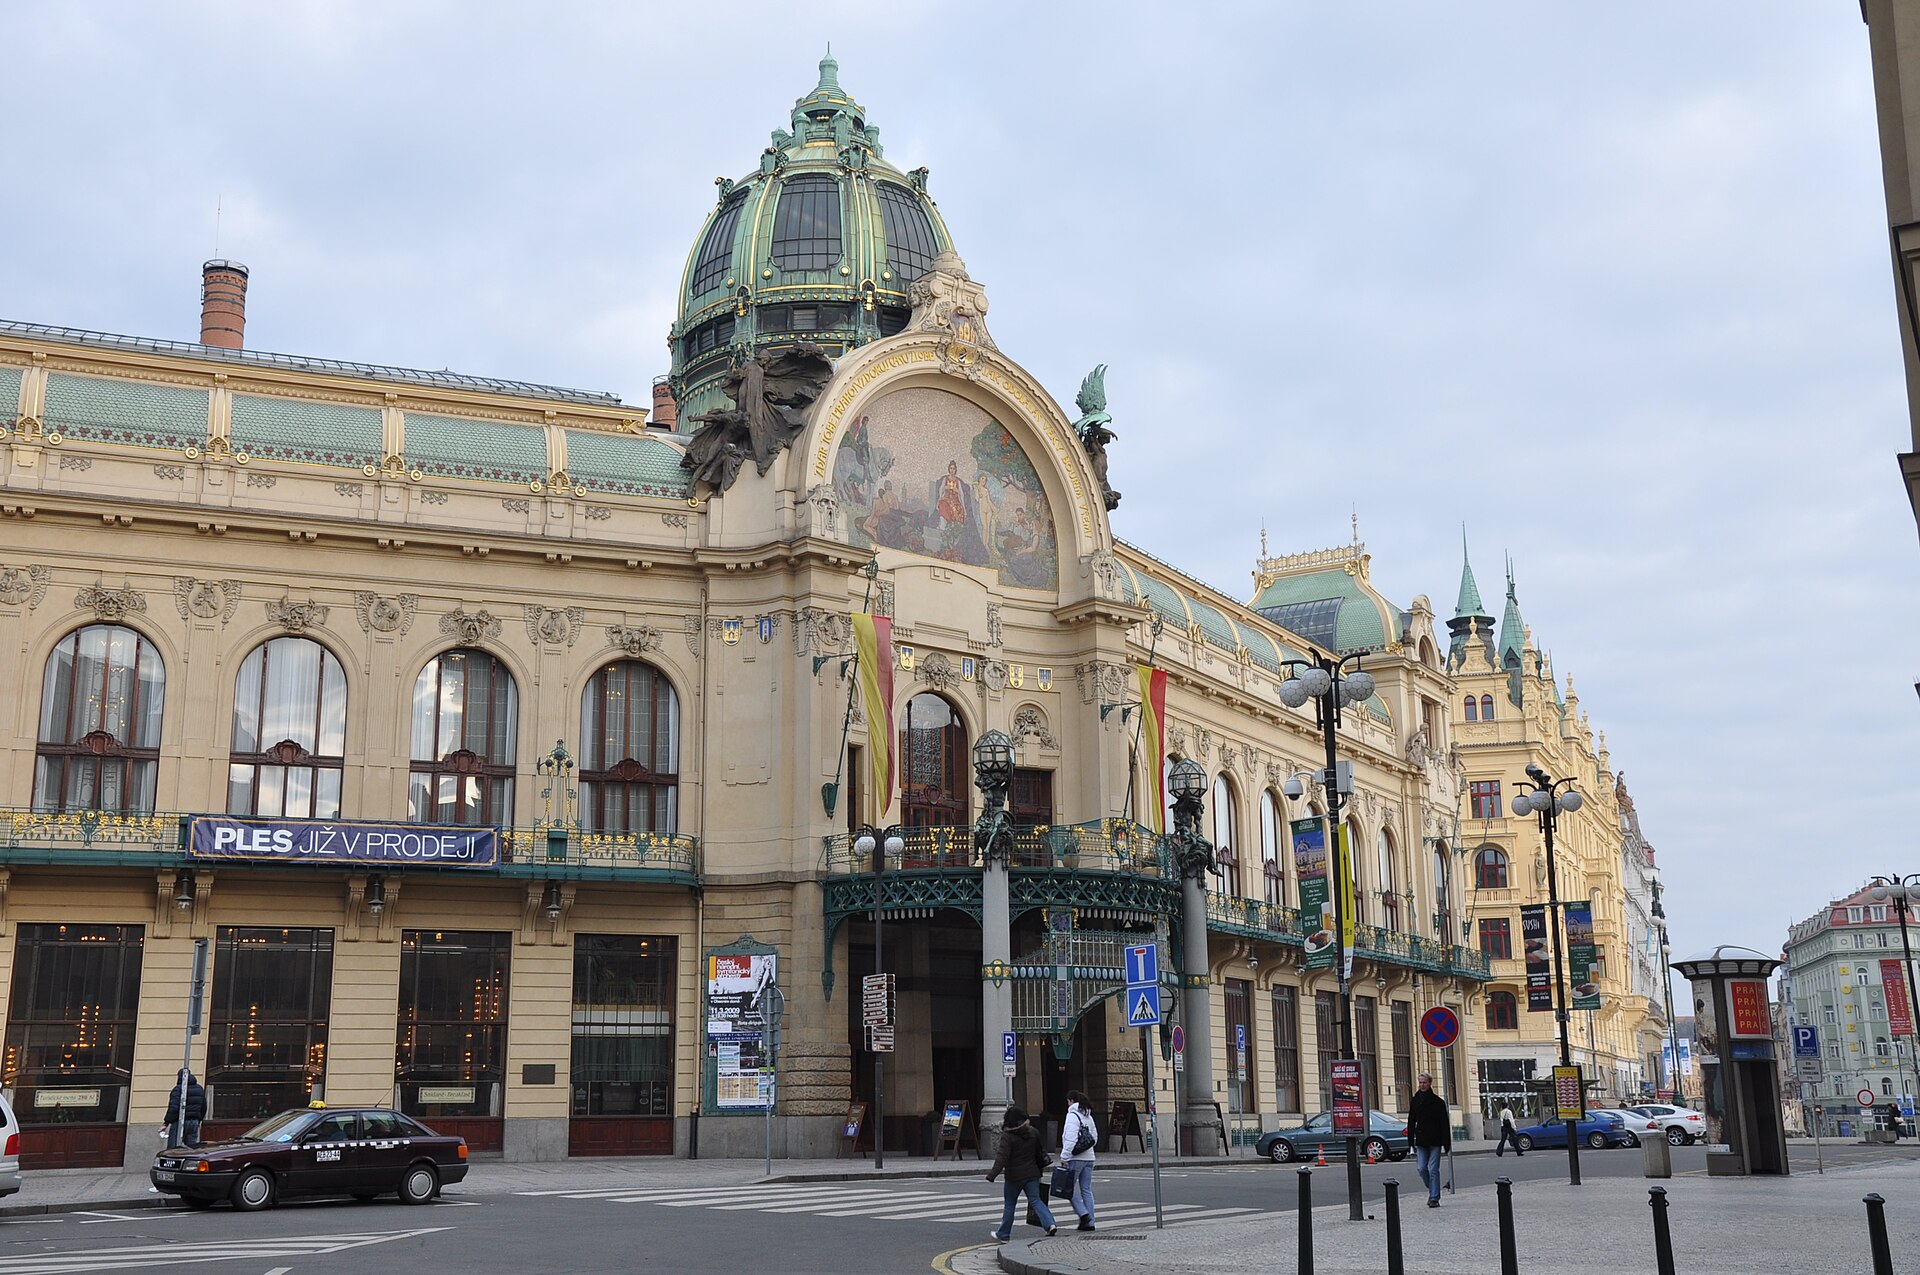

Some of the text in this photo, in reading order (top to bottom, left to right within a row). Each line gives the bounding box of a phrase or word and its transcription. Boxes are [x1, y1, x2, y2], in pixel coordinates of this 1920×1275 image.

[214, 825, 475, 859] PLES JIŽ V PRODEJI
[1840, 966, 1858, 1053] HOTEL
[1005, 1035, 1013, 1054] P
[1238, 1028, 1243, 1042] P
[1798, 1028, 1812, 1047] P
